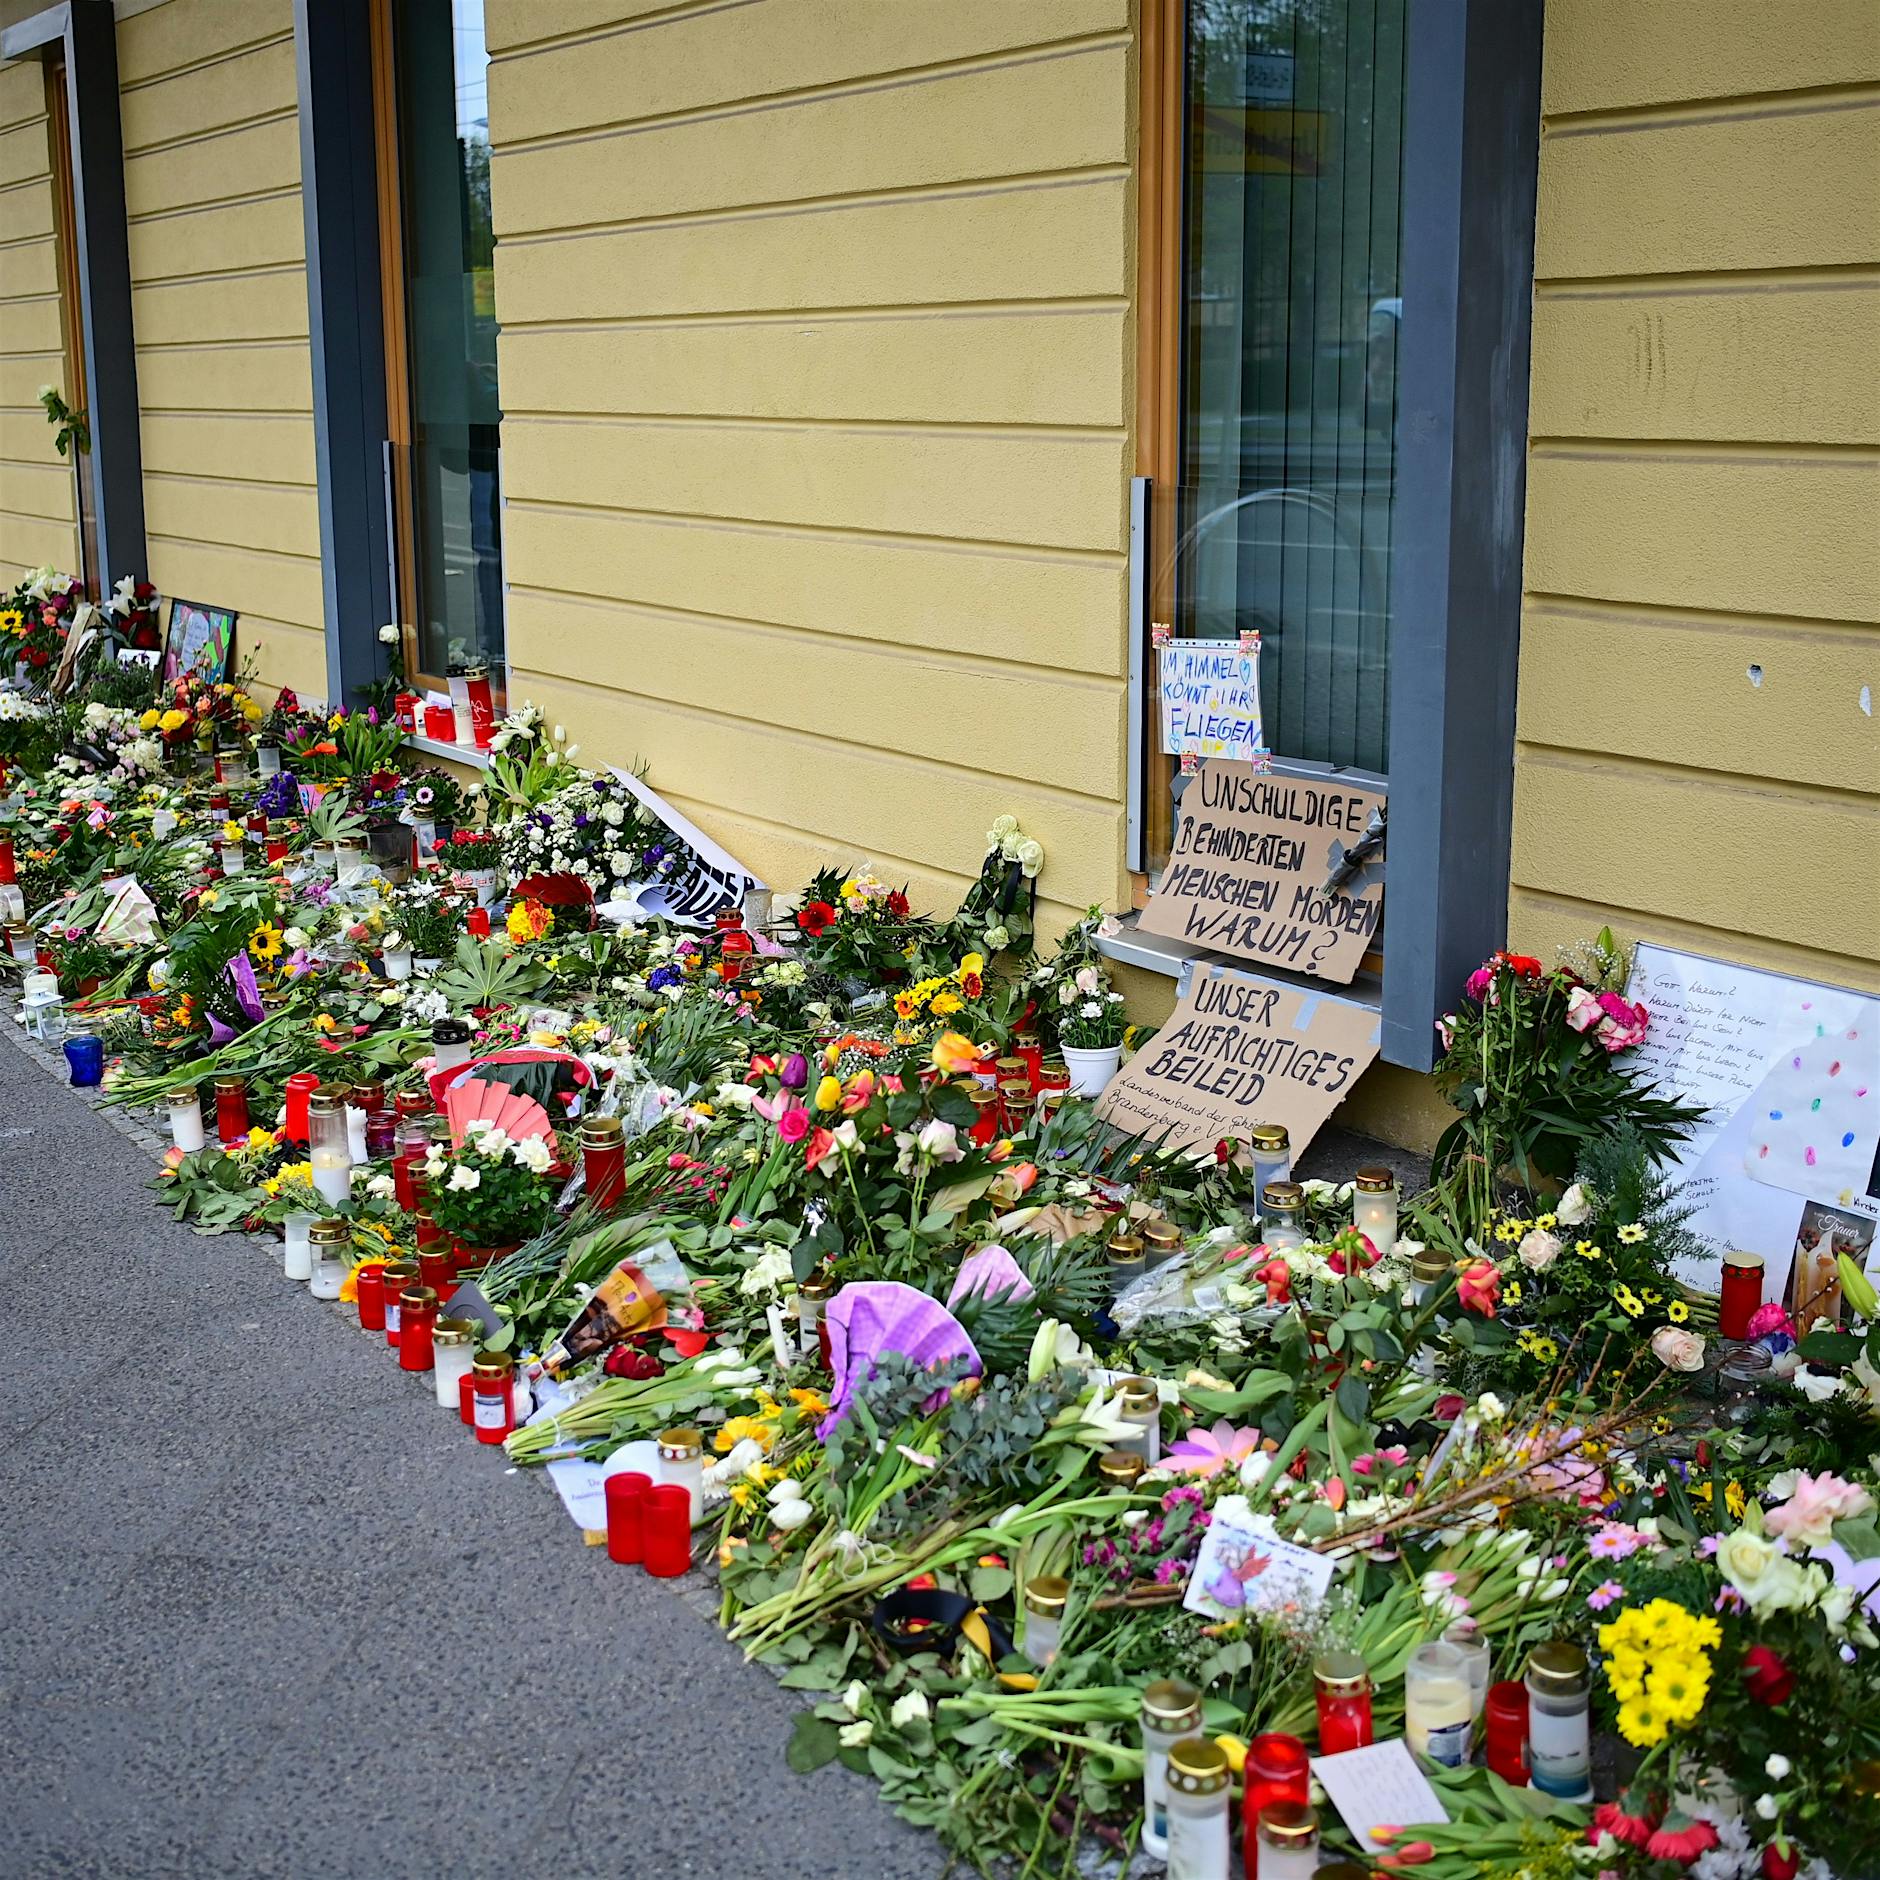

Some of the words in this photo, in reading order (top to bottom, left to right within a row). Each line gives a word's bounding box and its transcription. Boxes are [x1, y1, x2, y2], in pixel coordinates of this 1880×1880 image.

[1163, 650, 1177, 675] IM
[1184, 655, 1239, 680] HIMMEL
[1163, 674, 1212, 705] KÖNNT
[1171, 708, 1262, 747] FLIEGEN
[1201, 769, 1364, 833] UNSCHULDIGE
[1176, 816, 1305, 871] BEHINDERTEN
[1162, 864, 1280, 913] MENSCHEN
[1194, 978, 1280, 1028] UNSER
[1145, 1048, 1266, 1106] BEILEID
[1165, 1020, 1355, 1093] AUFRICHTIGES
[1107, 1089, 1189, 1139] Brandenburg
[1119, 1076, 1207, 1116] Landesverband
[1207, 1109, 1228, 1123] der
[1818, 1214, 1860, 1239] Trauer
